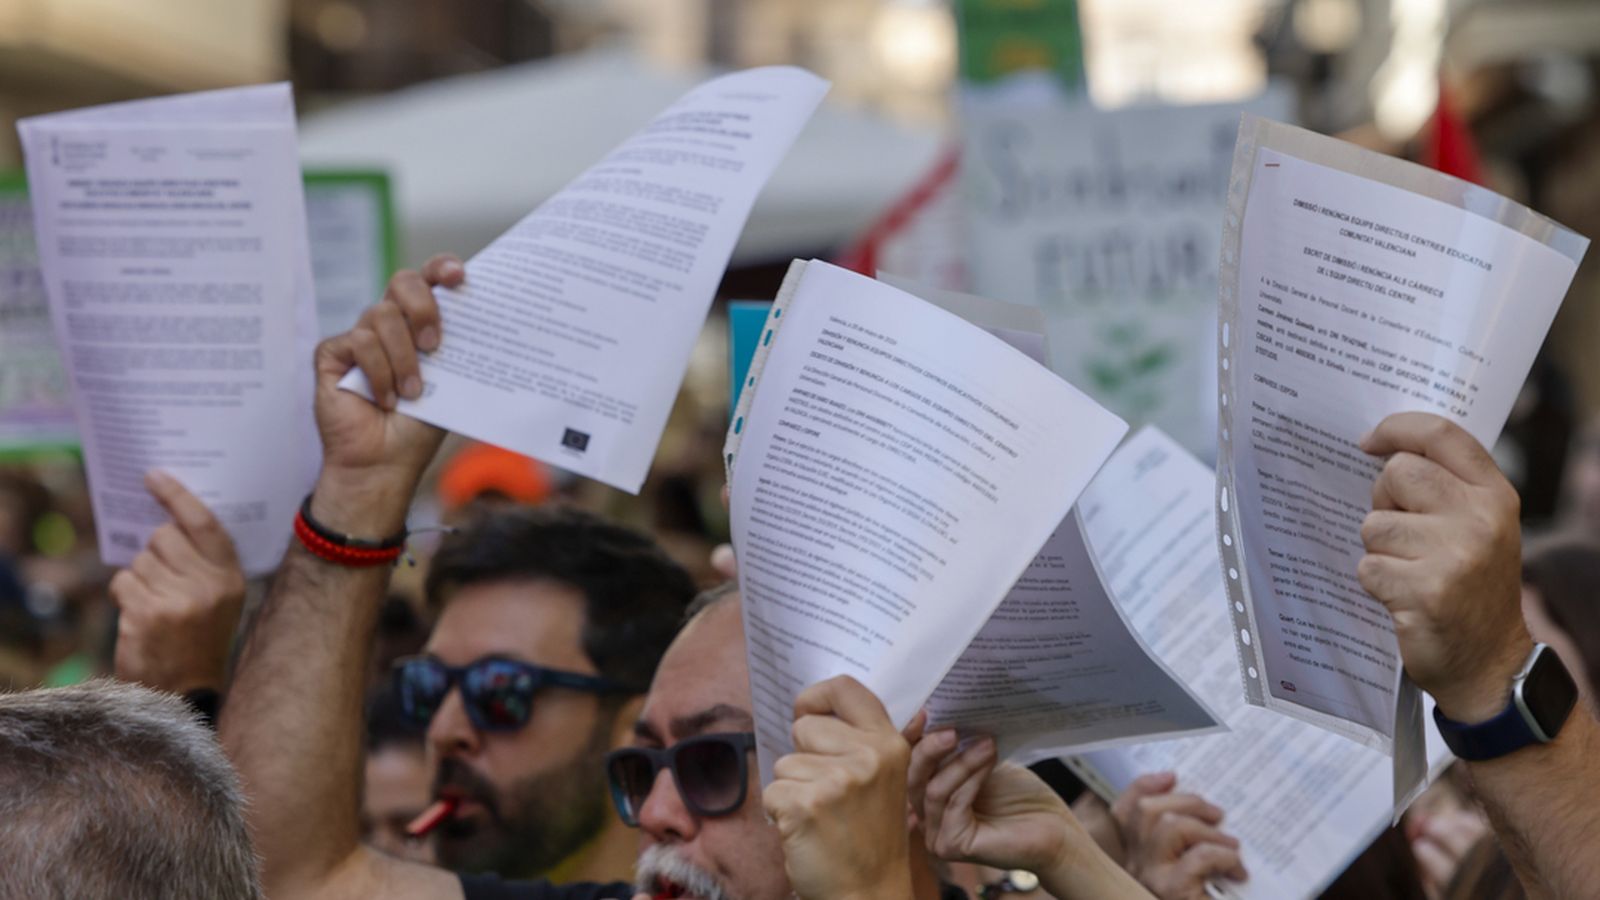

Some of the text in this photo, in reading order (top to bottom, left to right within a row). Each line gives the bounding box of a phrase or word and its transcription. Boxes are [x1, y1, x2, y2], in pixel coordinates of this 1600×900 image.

[1339, 228, 1416, 257] COMUNITAT VALENCIANA
[1350, 217, 1373, 229] EQUIPS
[1374, 223, 1409, 240] DIRECTIUS
[1410, 234, 1445, 252] CENTRES
[1446, 247, 1492, 271] EDUCATIUS
[1393, 275, 1406, 285] ALS
[1375, 284, 1386, 294] DEL
[1388, 288, 1416, 303] CENTRE
